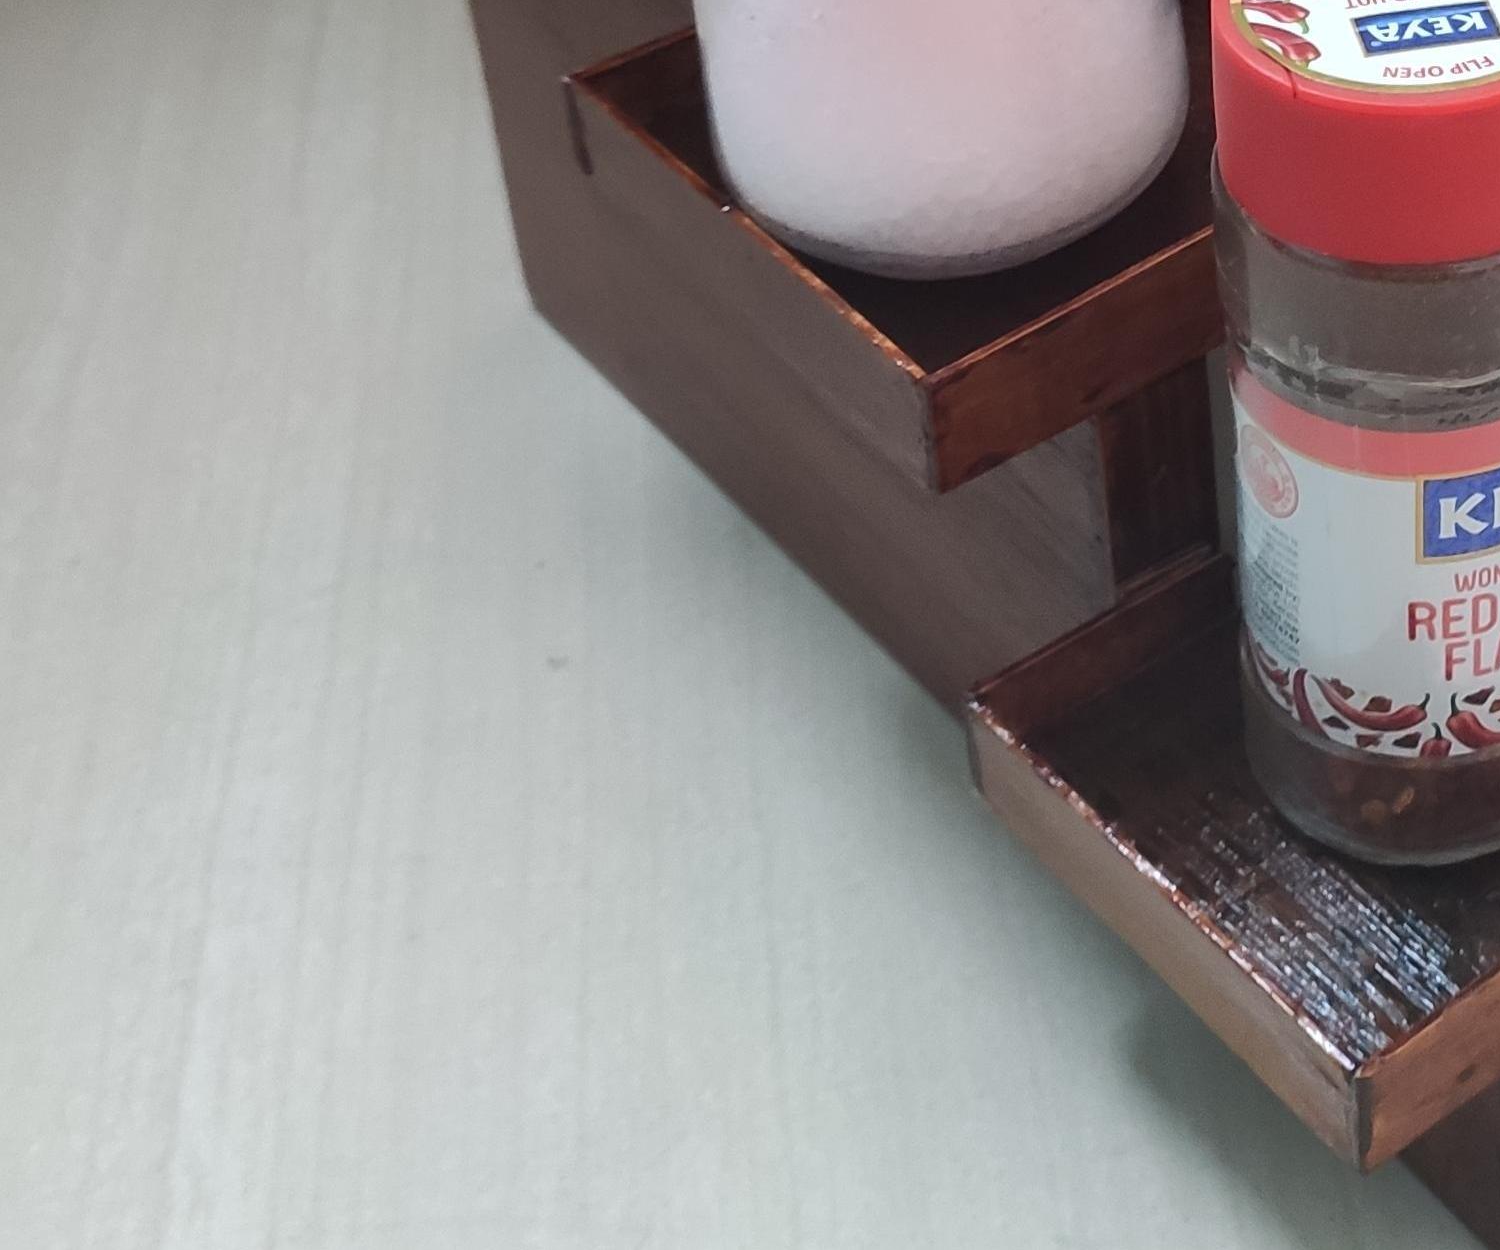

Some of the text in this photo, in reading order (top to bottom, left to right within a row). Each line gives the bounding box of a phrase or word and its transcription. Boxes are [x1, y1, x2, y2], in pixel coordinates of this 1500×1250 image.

[1367, 11, 1488, 43] KEYA
[1382, 55, 1495, 79] FLIP OPEN
[1407, 593, 1498, 641] RED
